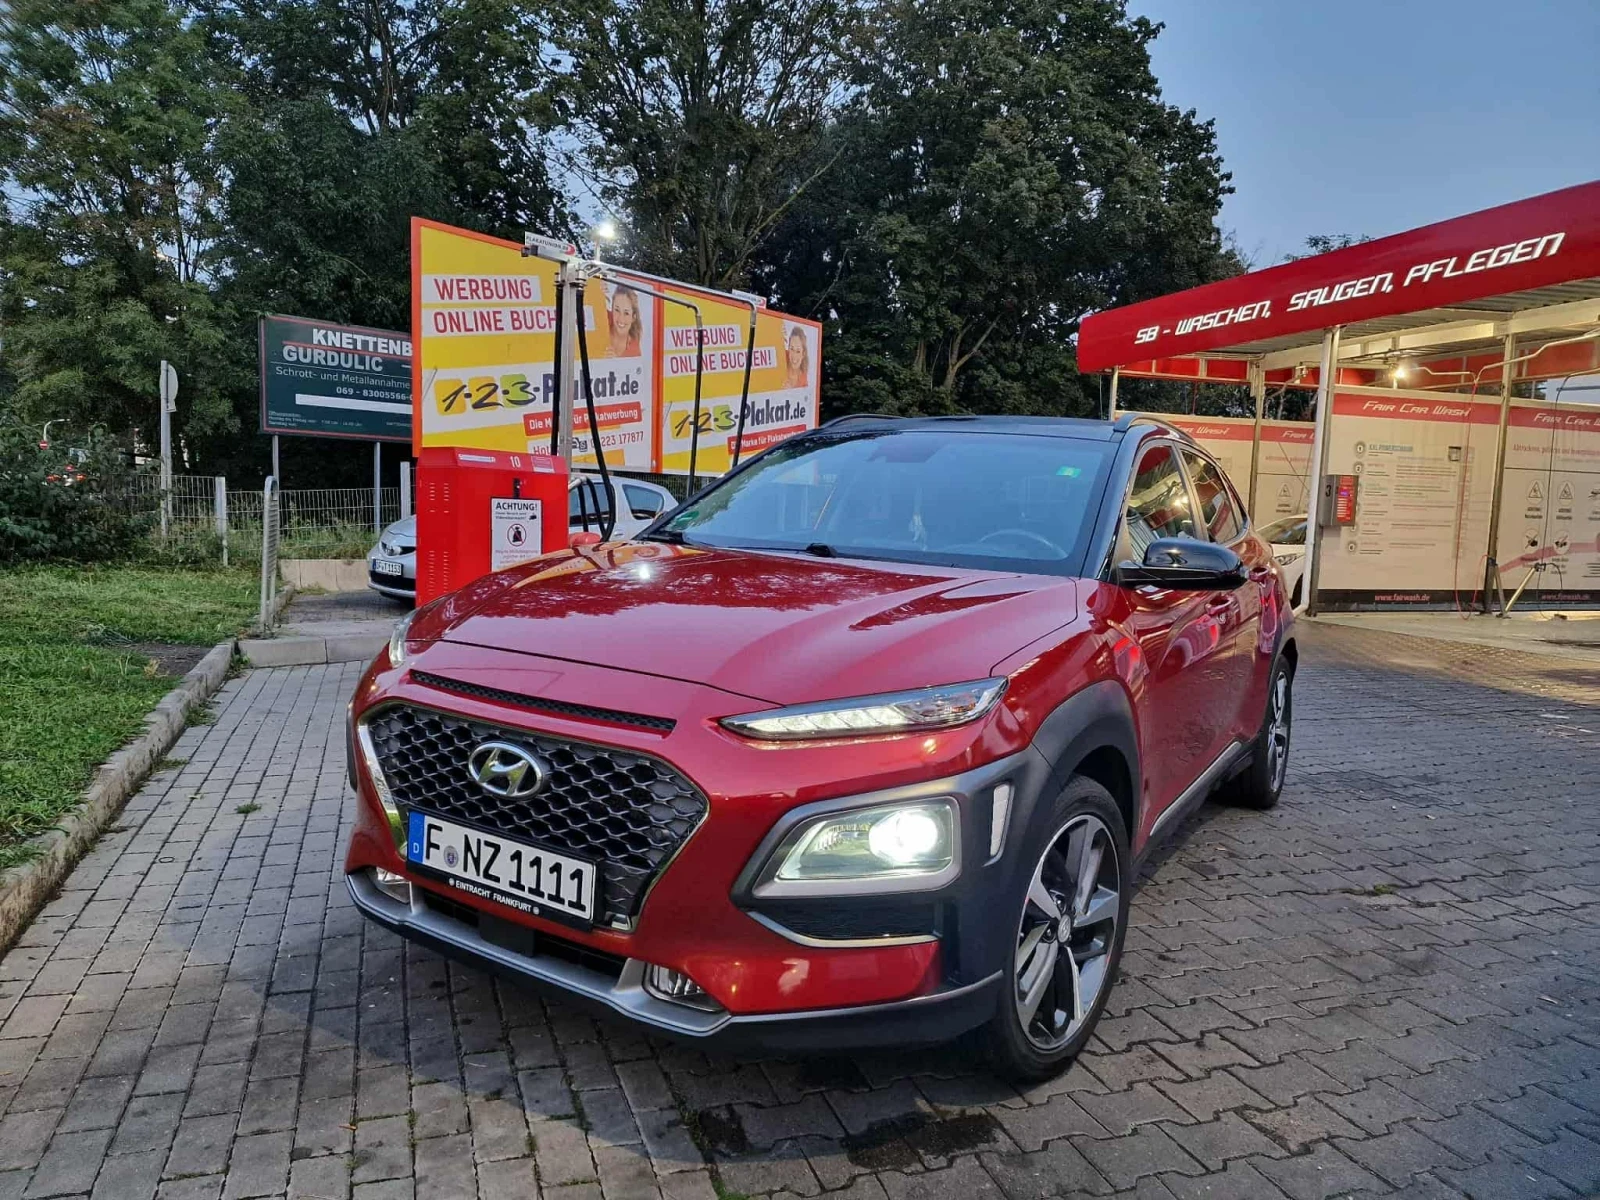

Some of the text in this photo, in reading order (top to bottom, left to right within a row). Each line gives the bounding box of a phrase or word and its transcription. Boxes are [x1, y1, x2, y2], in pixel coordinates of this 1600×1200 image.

[434, 278, 532, 300] WERBUNG
[1134, 325, 1160, 345] SB
[1174, 300, 1271, 336] WASCHEN,
[1287, 272, 1394, 312] SAUGEN,
[1403, 232, 1566, 287] PFLEGEN
[433, 311, 504, 333] ONLINE
[282, 345, 384, 371] GURDULIC
[275, 366, 411, 390] Schrott- und Metallannahme
[336, 387, 354, 395] 069
[529, 419, 543, 430] Die
[618, 431, 644, 445] 177877
[510, 456, 521, 468] 10
[1325, 484, 1332, 497] 3
[495, 502, 538, 511] ACHTUNG!
[413, 843, 420, 854] D
[425, 823, 587, 912] F NZ 1111
[455, 877, 532, 913] EINTRACHT FRANKFURT
